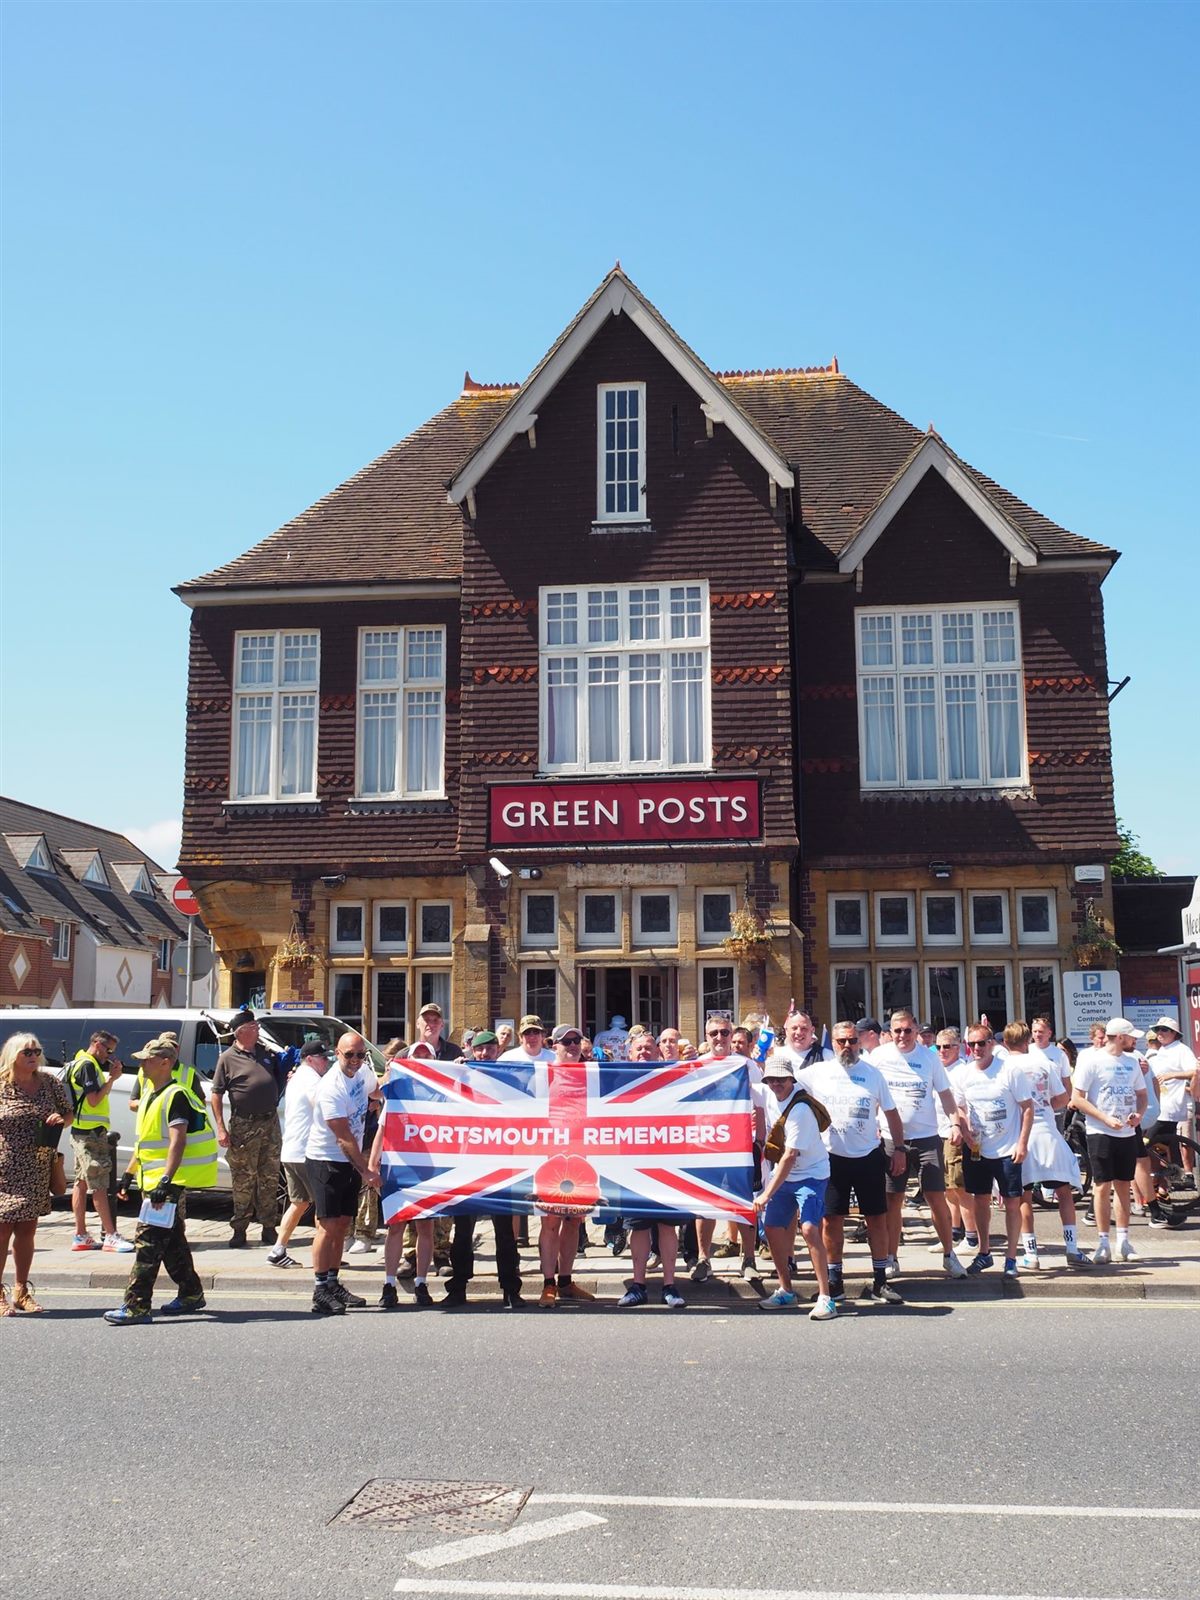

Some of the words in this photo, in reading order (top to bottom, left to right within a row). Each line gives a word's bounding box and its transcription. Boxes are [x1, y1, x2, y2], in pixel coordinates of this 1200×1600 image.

[502, 799, 618, 828] GREEN
[638, 796, 748, 824] POSTS
[1097, 999, 1113, 1007] Only
[404, 1124, 570, 1146] PORTSMOUTH
[583, 1124, 731, 1145] REMEMBERS
[553, 1206, 566, 1214] WE
